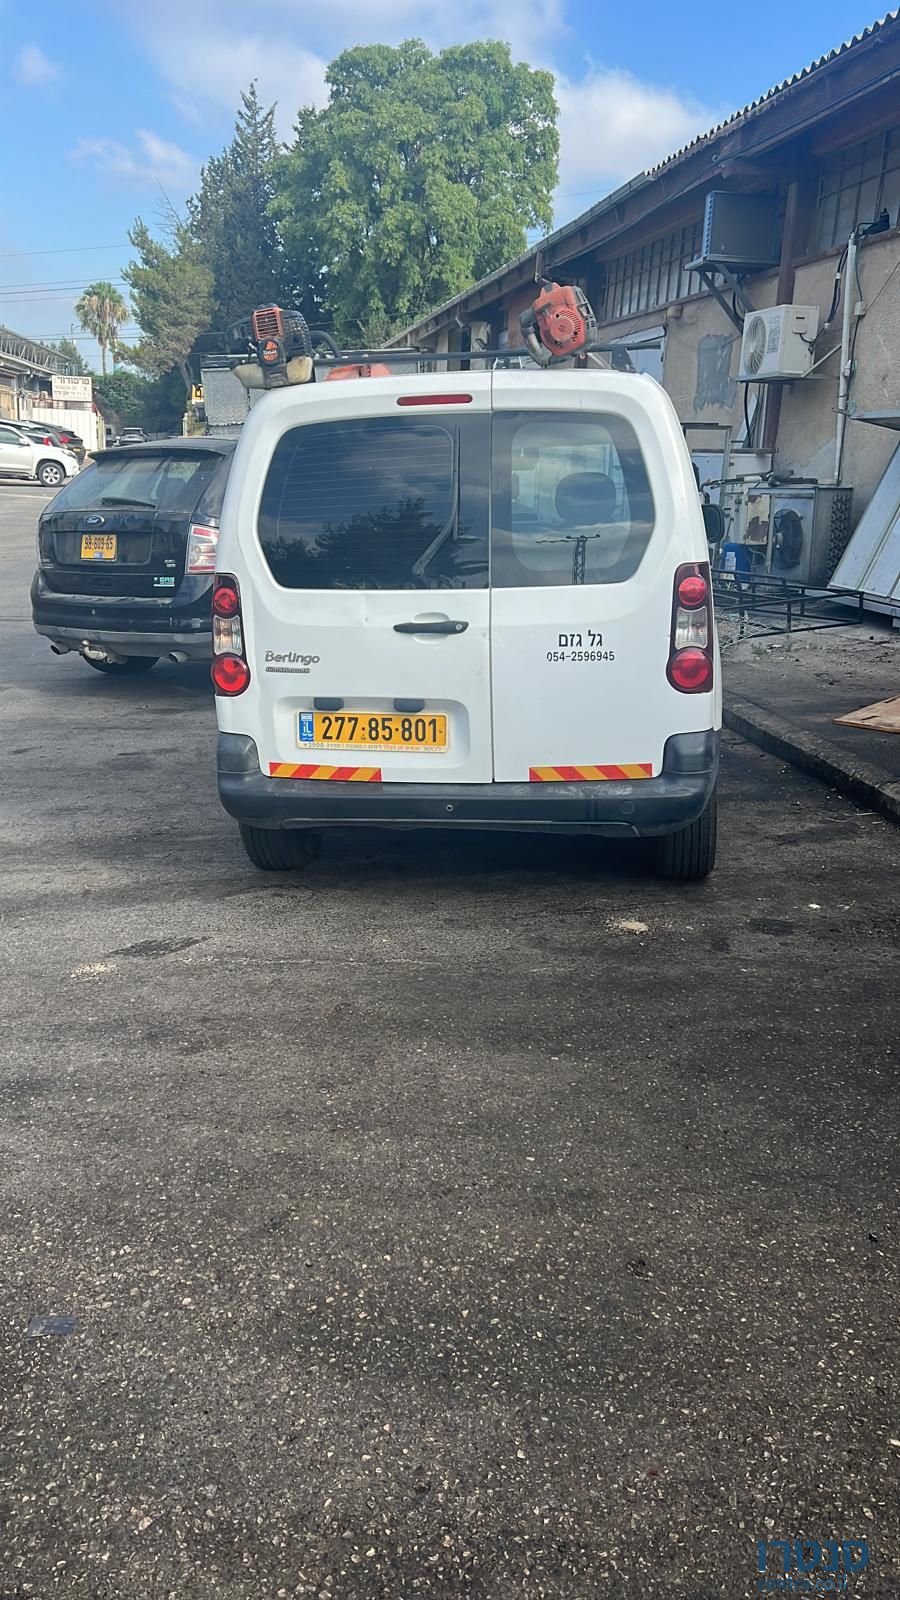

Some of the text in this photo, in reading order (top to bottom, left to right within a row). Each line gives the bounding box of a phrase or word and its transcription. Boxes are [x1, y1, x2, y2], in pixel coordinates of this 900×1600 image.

[558, 629, 603, 647] גל גזם
[264, 650, 320, 666] Berlingo
[546, 650, 615, 662] 054-2596945
